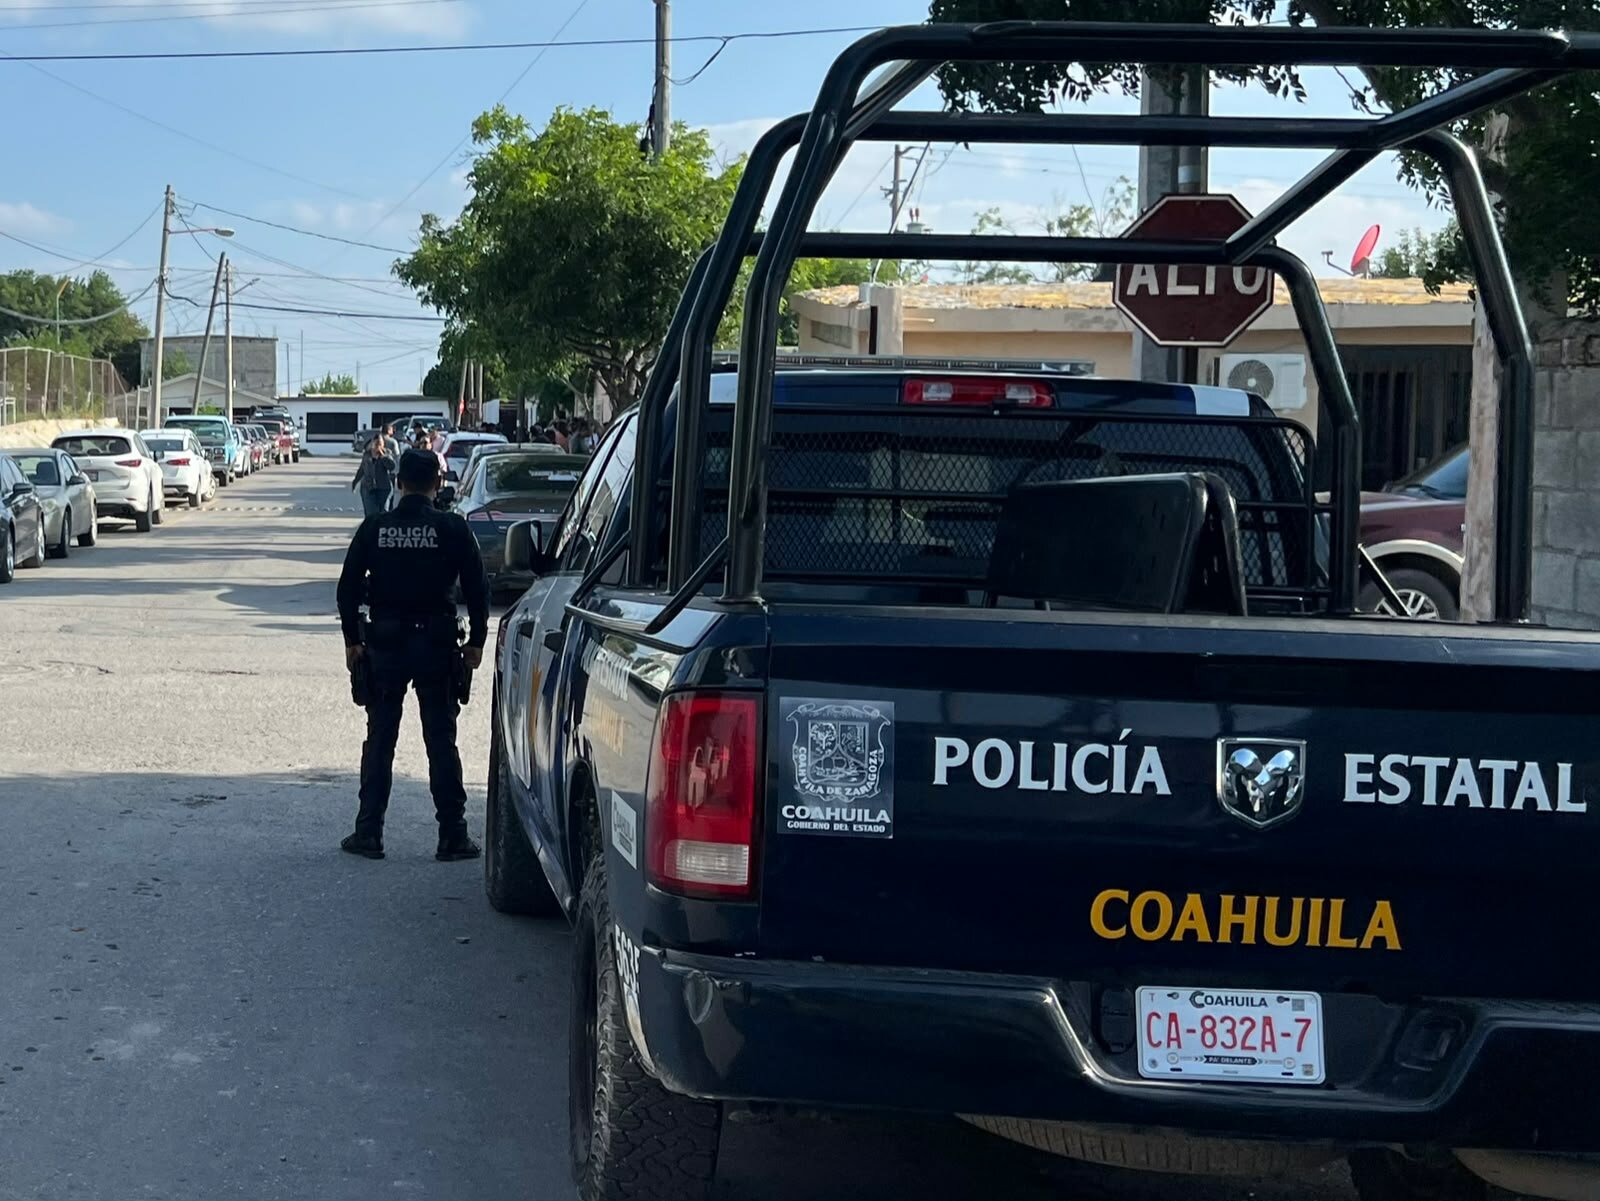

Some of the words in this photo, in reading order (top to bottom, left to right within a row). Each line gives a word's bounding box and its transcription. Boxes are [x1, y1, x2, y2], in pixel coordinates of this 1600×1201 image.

[378, 525, 438, 538] POLICÍA
[378, 537, 438, 548] ESTATAL
[826, 786, 843, 795] DE
[844, 749, 878, 796] ZARAGOZA
[932, 728, 1172, 796] POLICÍA
[1342, 753, 1587, 813] ESTATAL
[781, 805, 891, 824] COAHUILA
[787, 820, 830, 831] GOBIERNO
[833, 823, 849, 831] DEL
[853, 824, 886, 833] ESTADO
[1089, 888, 1402, 951] COAHUILA
[1188, 990, 1268, 1009] COAHUILA
[1146, 1011, 1312, 1053] CA-832A-7
